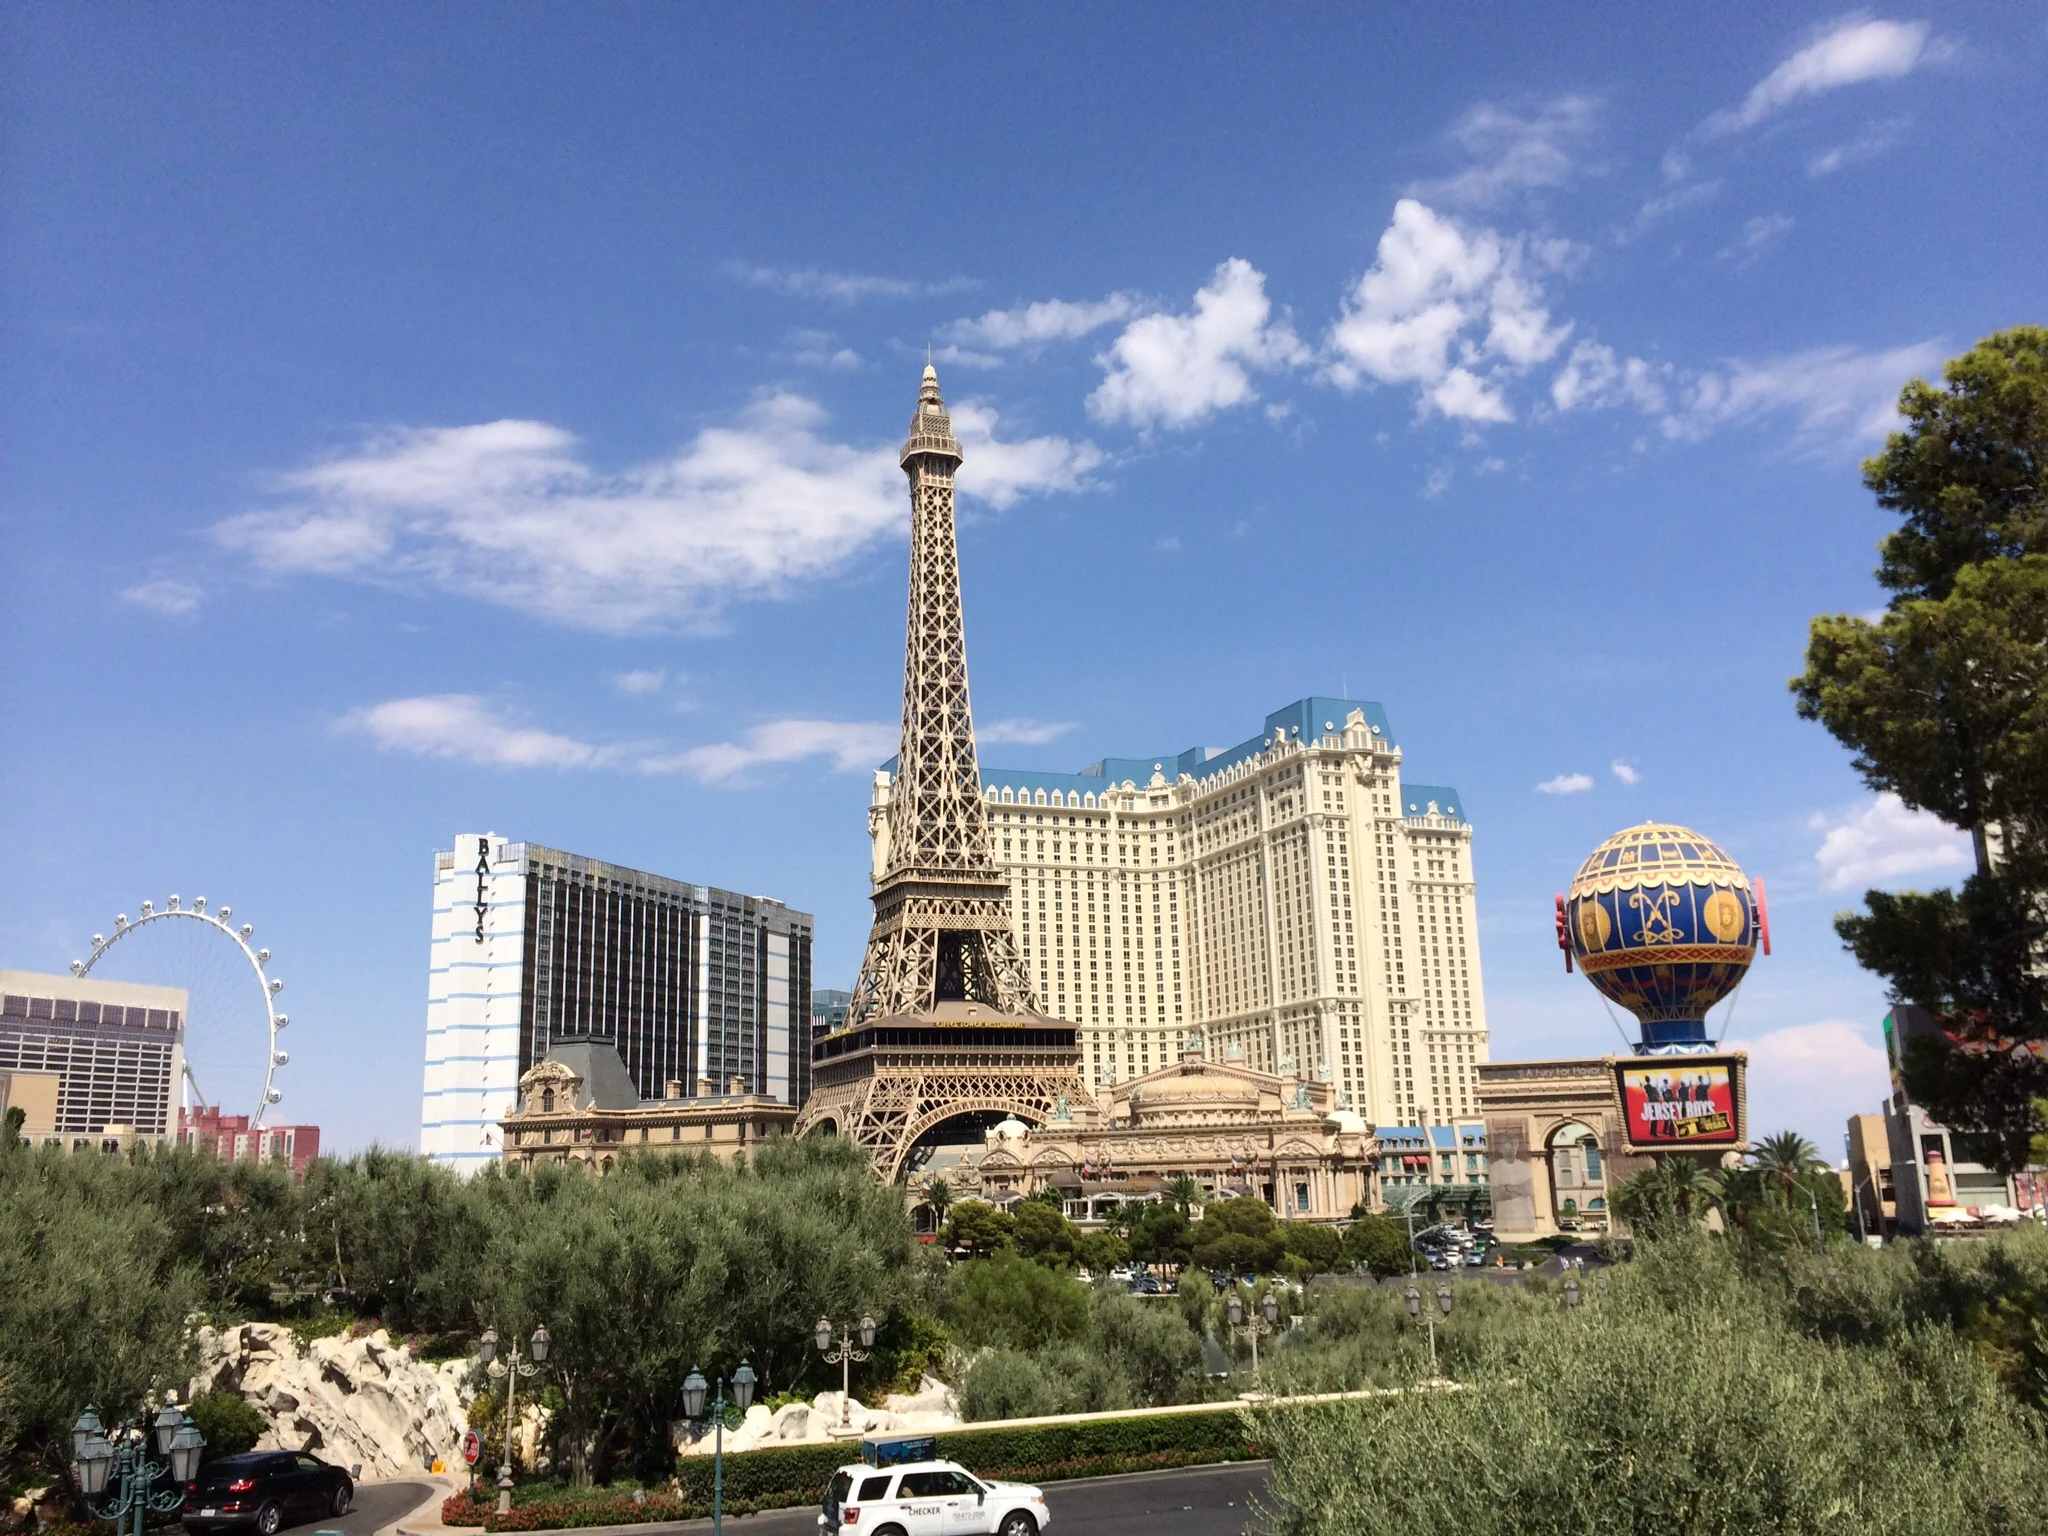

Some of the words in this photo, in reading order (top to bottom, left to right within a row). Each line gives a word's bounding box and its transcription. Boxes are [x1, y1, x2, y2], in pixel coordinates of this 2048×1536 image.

[1641, 1101, 1682, 1120] JERSEY
[1686, 1100, 1715, 1117] BOYS
[909, 1507, 941, 1516] CHECKER
